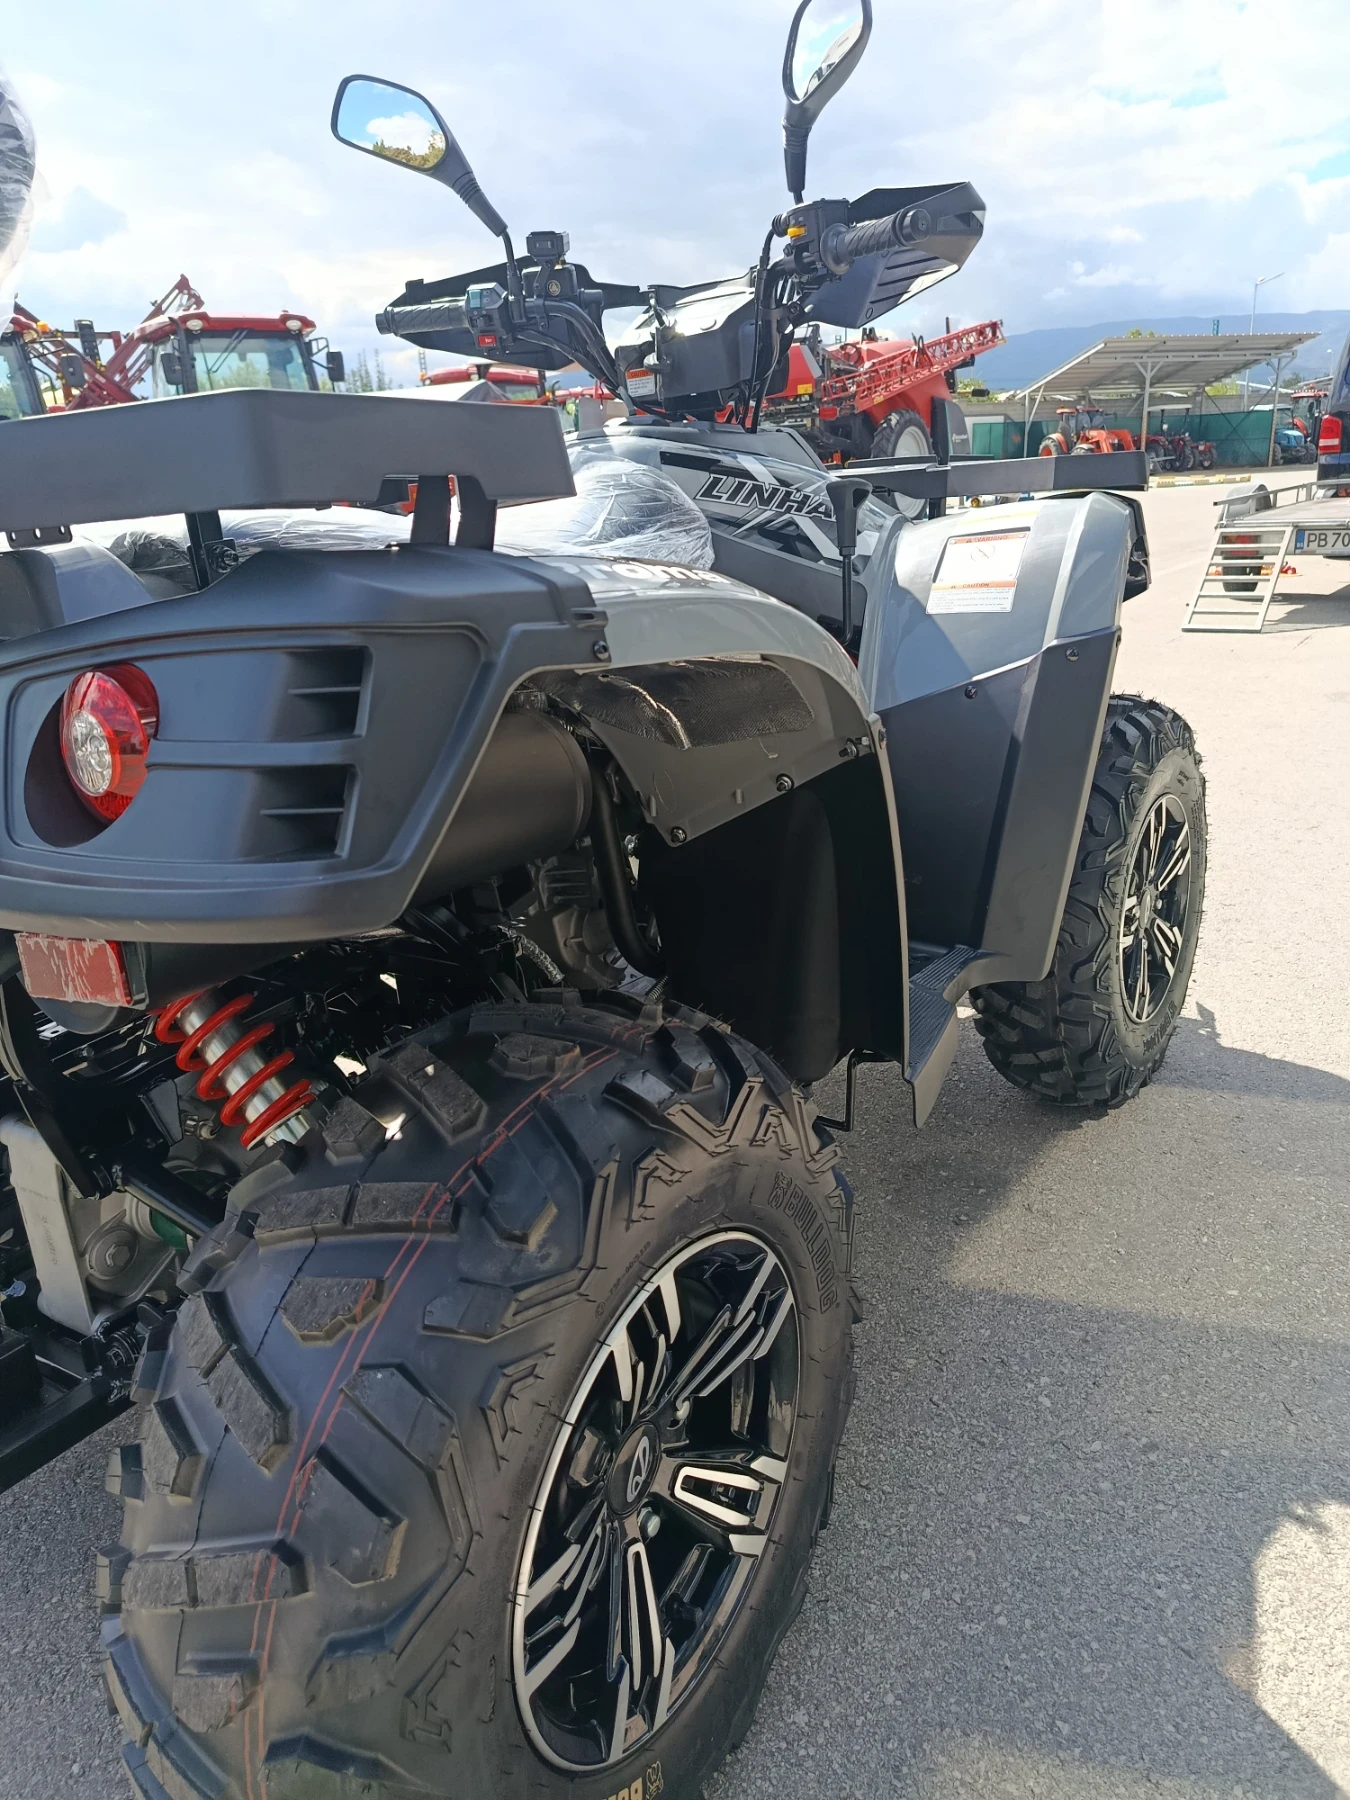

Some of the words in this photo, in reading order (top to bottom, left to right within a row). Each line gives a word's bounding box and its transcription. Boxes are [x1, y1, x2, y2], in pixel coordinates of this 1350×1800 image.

[694, 474, 837, 522] LINHA
[1307, 533, 1328, 548] PB
[1331, 533, 1350, 548] 70
[782, 1184, 838, 1314] BULLDOG
